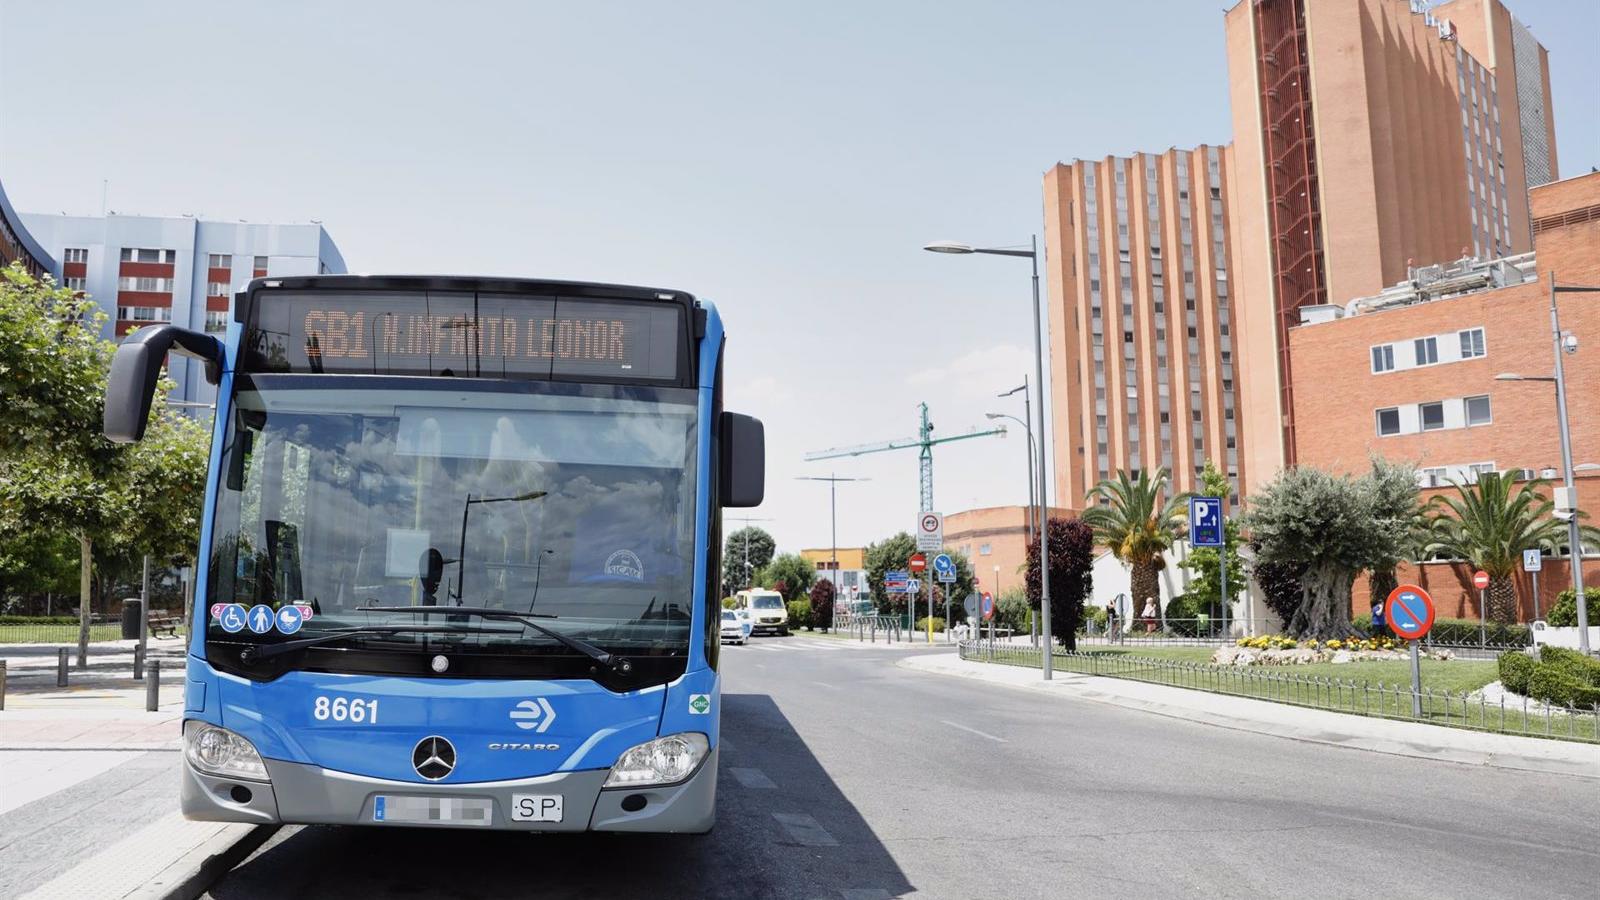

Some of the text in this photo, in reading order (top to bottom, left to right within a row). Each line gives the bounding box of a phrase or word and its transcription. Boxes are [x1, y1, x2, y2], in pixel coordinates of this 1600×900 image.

[527, 318, 624, 360] LEONOR
[1195, 501, 1208, 526] P
[314, 696, 378, 724] 8661
[488, 743, 560, 751] CITARO
